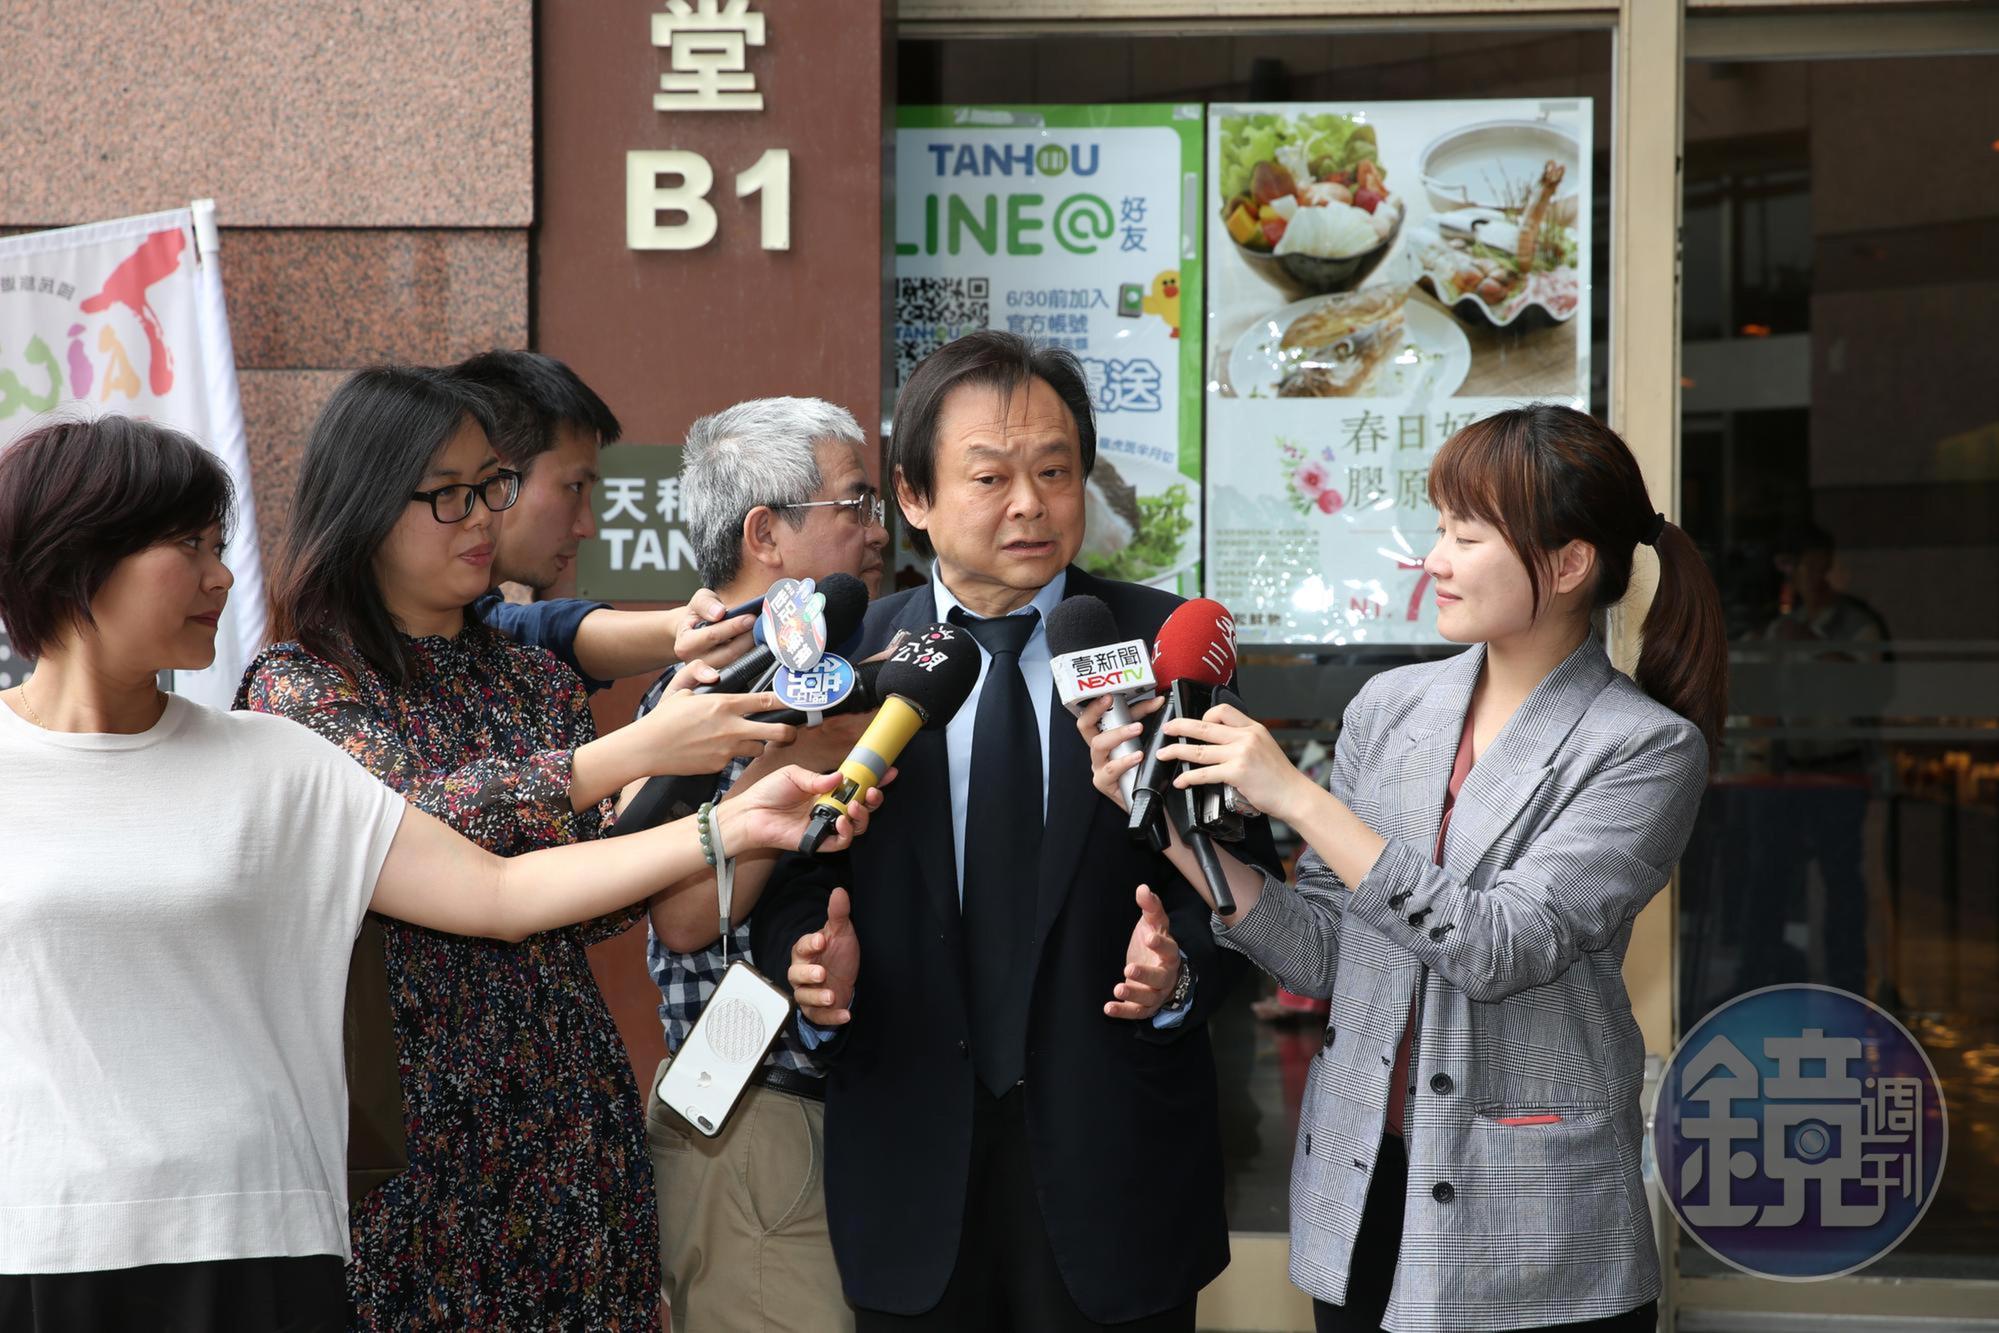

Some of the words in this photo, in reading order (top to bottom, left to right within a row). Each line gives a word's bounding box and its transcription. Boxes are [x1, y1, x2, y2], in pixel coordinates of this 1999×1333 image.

[651, 0, 766, 111] 堂
[626, 149, 790, 250] B1
[1120, 196, 1147, 252] 好友
[891, 642, 949, 673] 公視
[1071, 645, 1142, 678] 壹新聞
